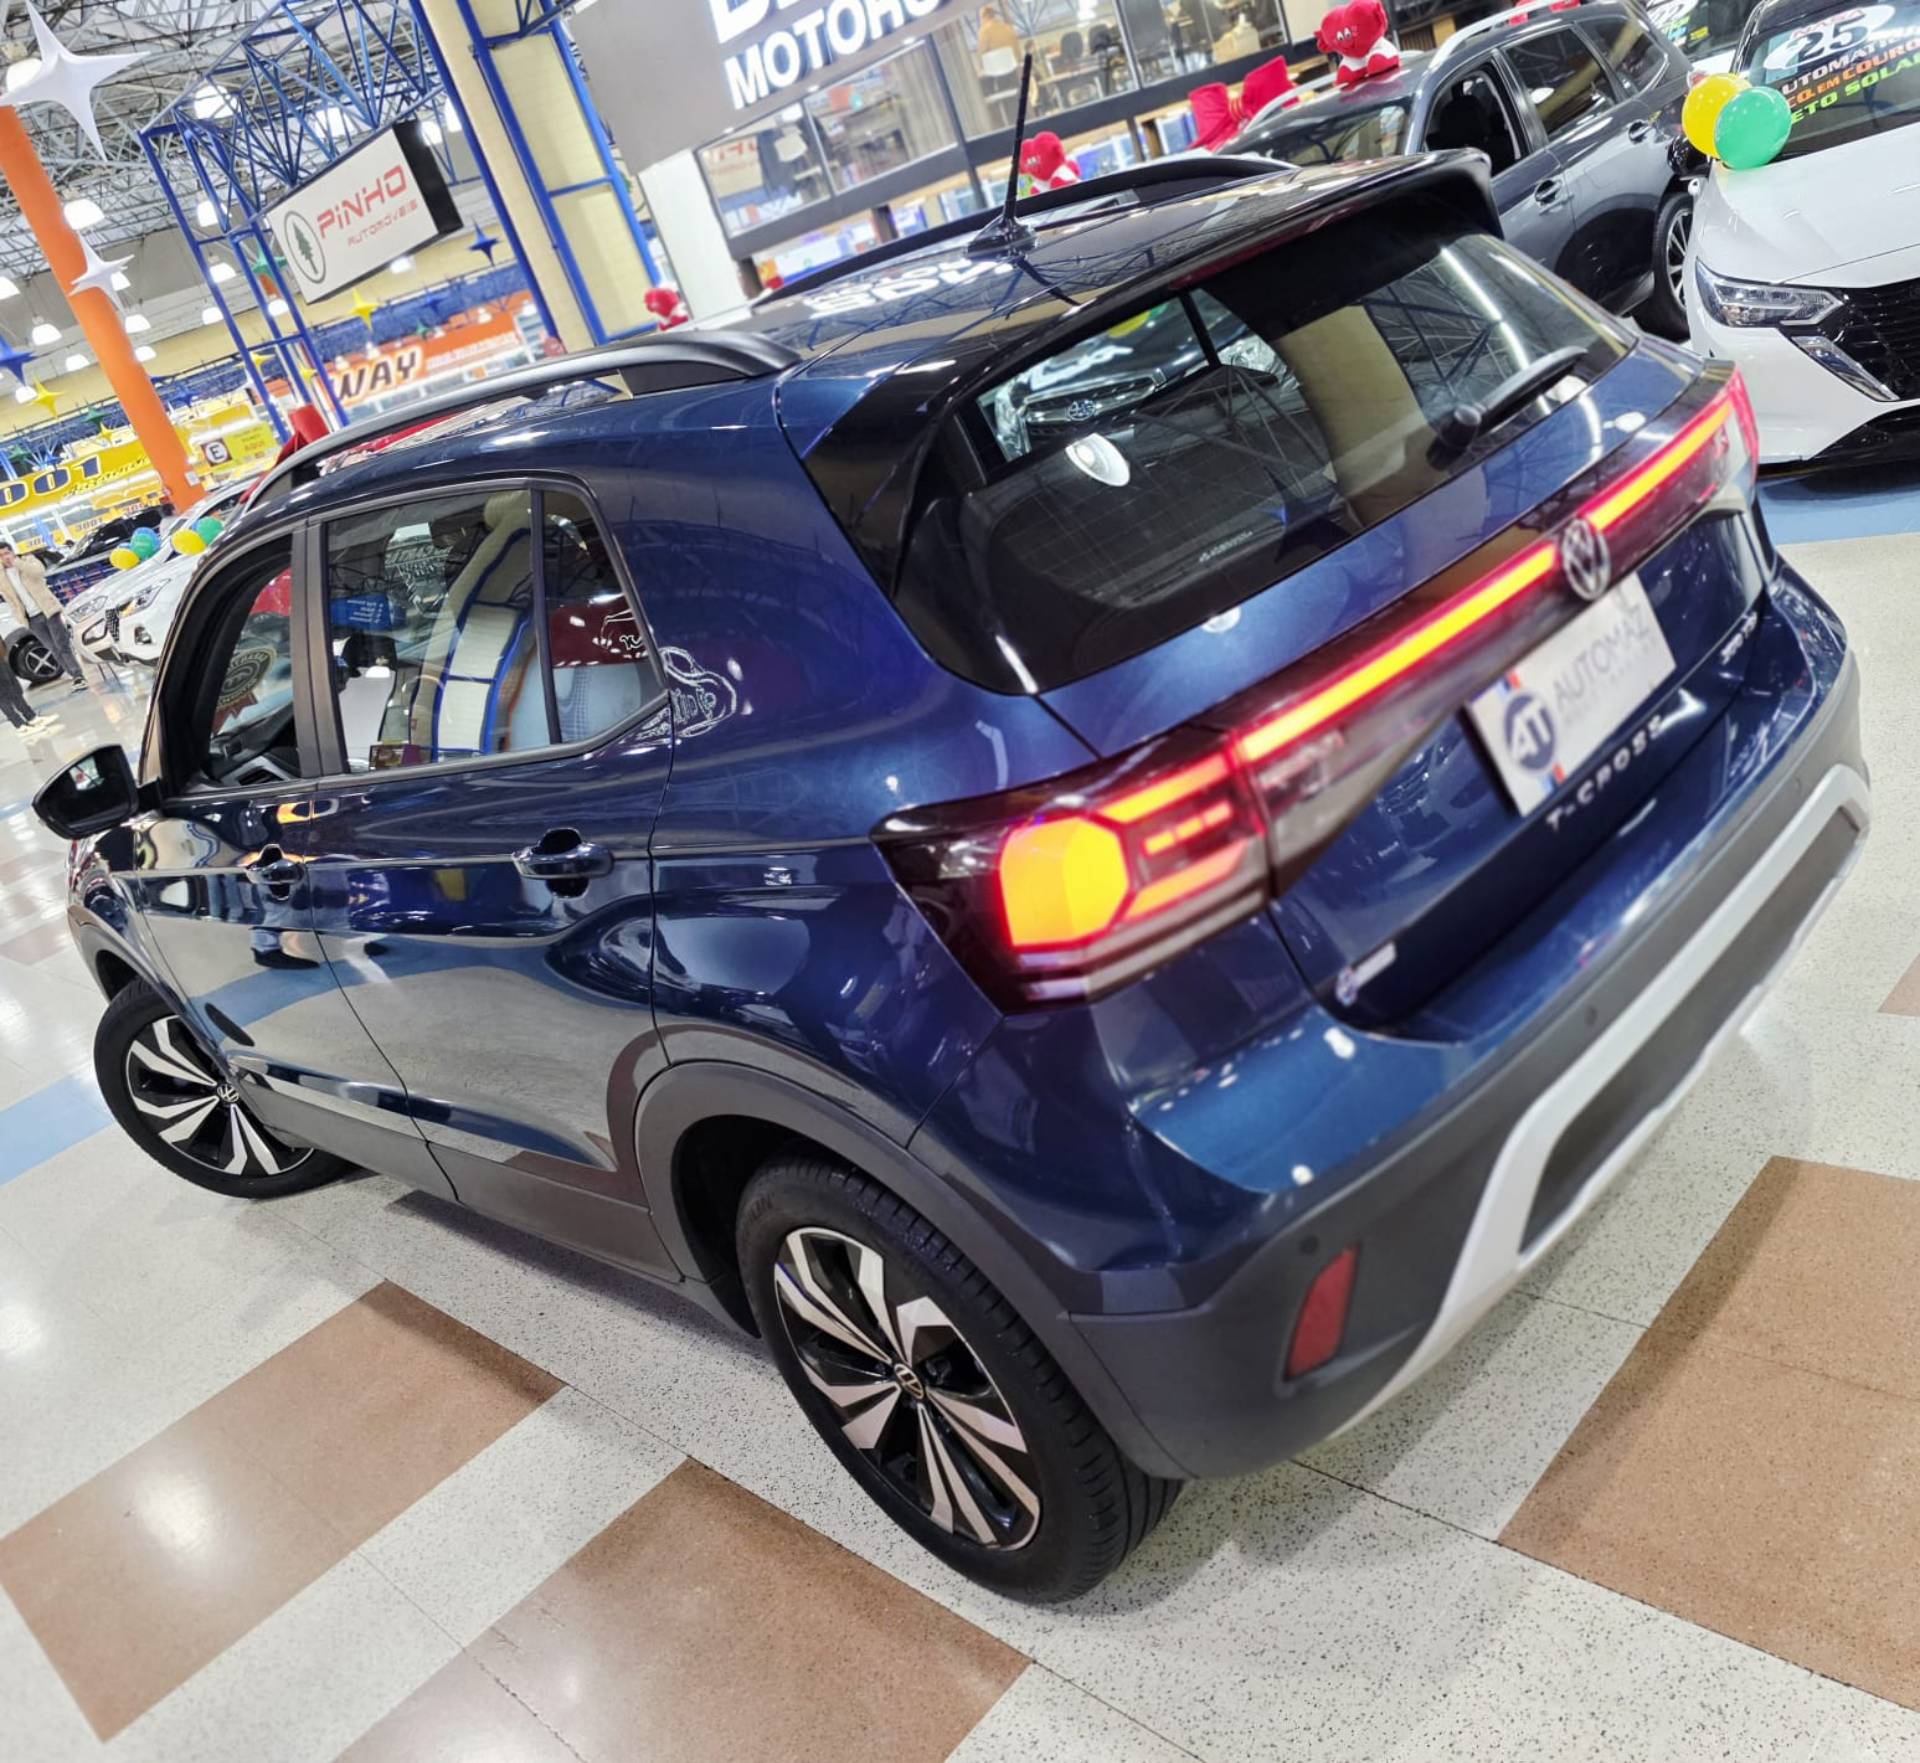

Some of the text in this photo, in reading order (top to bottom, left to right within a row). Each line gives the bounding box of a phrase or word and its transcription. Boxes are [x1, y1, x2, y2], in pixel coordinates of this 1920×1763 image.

[1785, 11, 1868, 69] 25
[1817, 78, 1840, 94] EM
[1791, 91, 1838, 125] ETO
[209, 444, 225, 461] E
